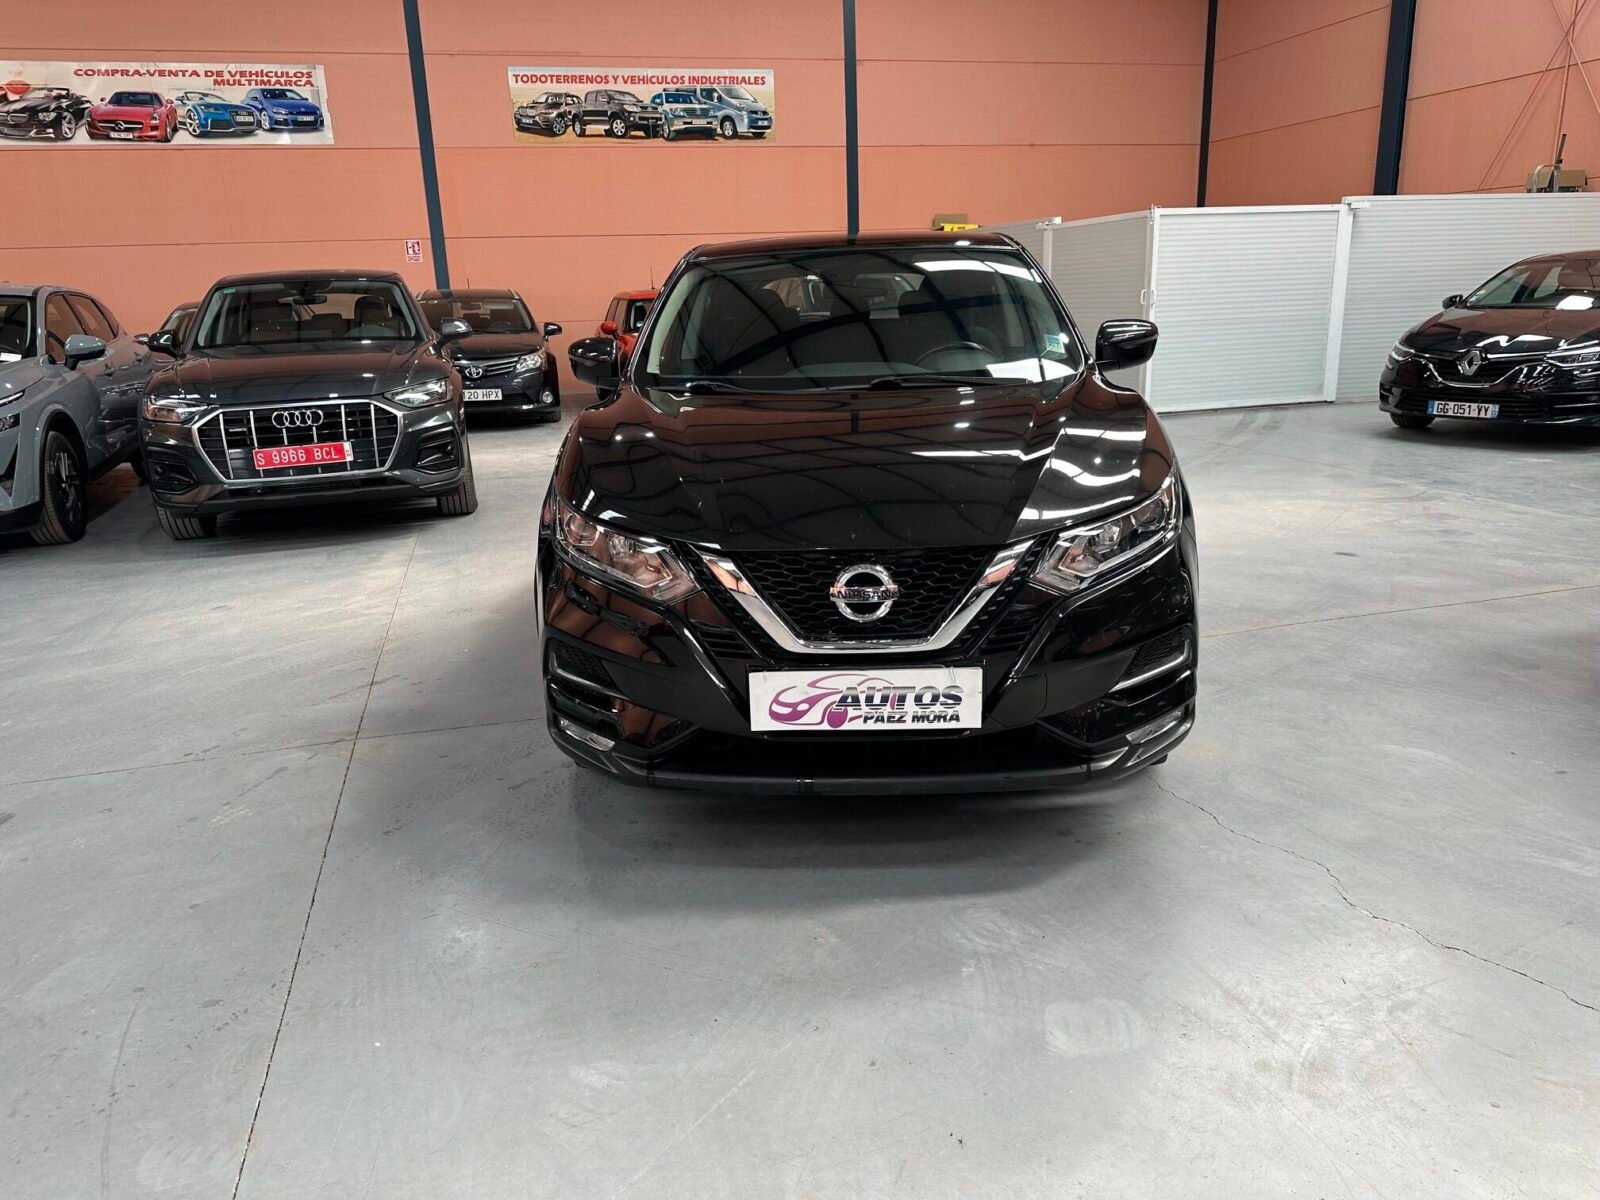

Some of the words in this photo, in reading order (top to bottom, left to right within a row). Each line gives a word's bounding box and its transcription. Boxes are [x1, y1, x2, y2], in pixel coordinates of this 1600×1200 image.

[73, 68, 200, 78] COMPRA-VENTA
[204, 70, 222, 78] DE
[227, 69, 313, 79] VEHÍCULOS
[213, 78, 315, 87] MULTIMARCA
[512, 74, 610, 85] TODOTERRENOS
[611, 75, 619, 84] Y
[621, 74, 686, 85] VEHÍCULOS
[688, 76, 766, 85] INDUSTRIALES
[481, 390, 500, 400] HPX
[1436, 402, 1490, 417] GG-051-YY
[257, 453, 265, 465] S
[272, 450, 306, 464] 9966
[314, 447, 339, 460] BCL
[838, 589, 891, 600] NISSAN
[833, 685, 964, 711] AUTOS
[911, 710, 961, 724] MORA
